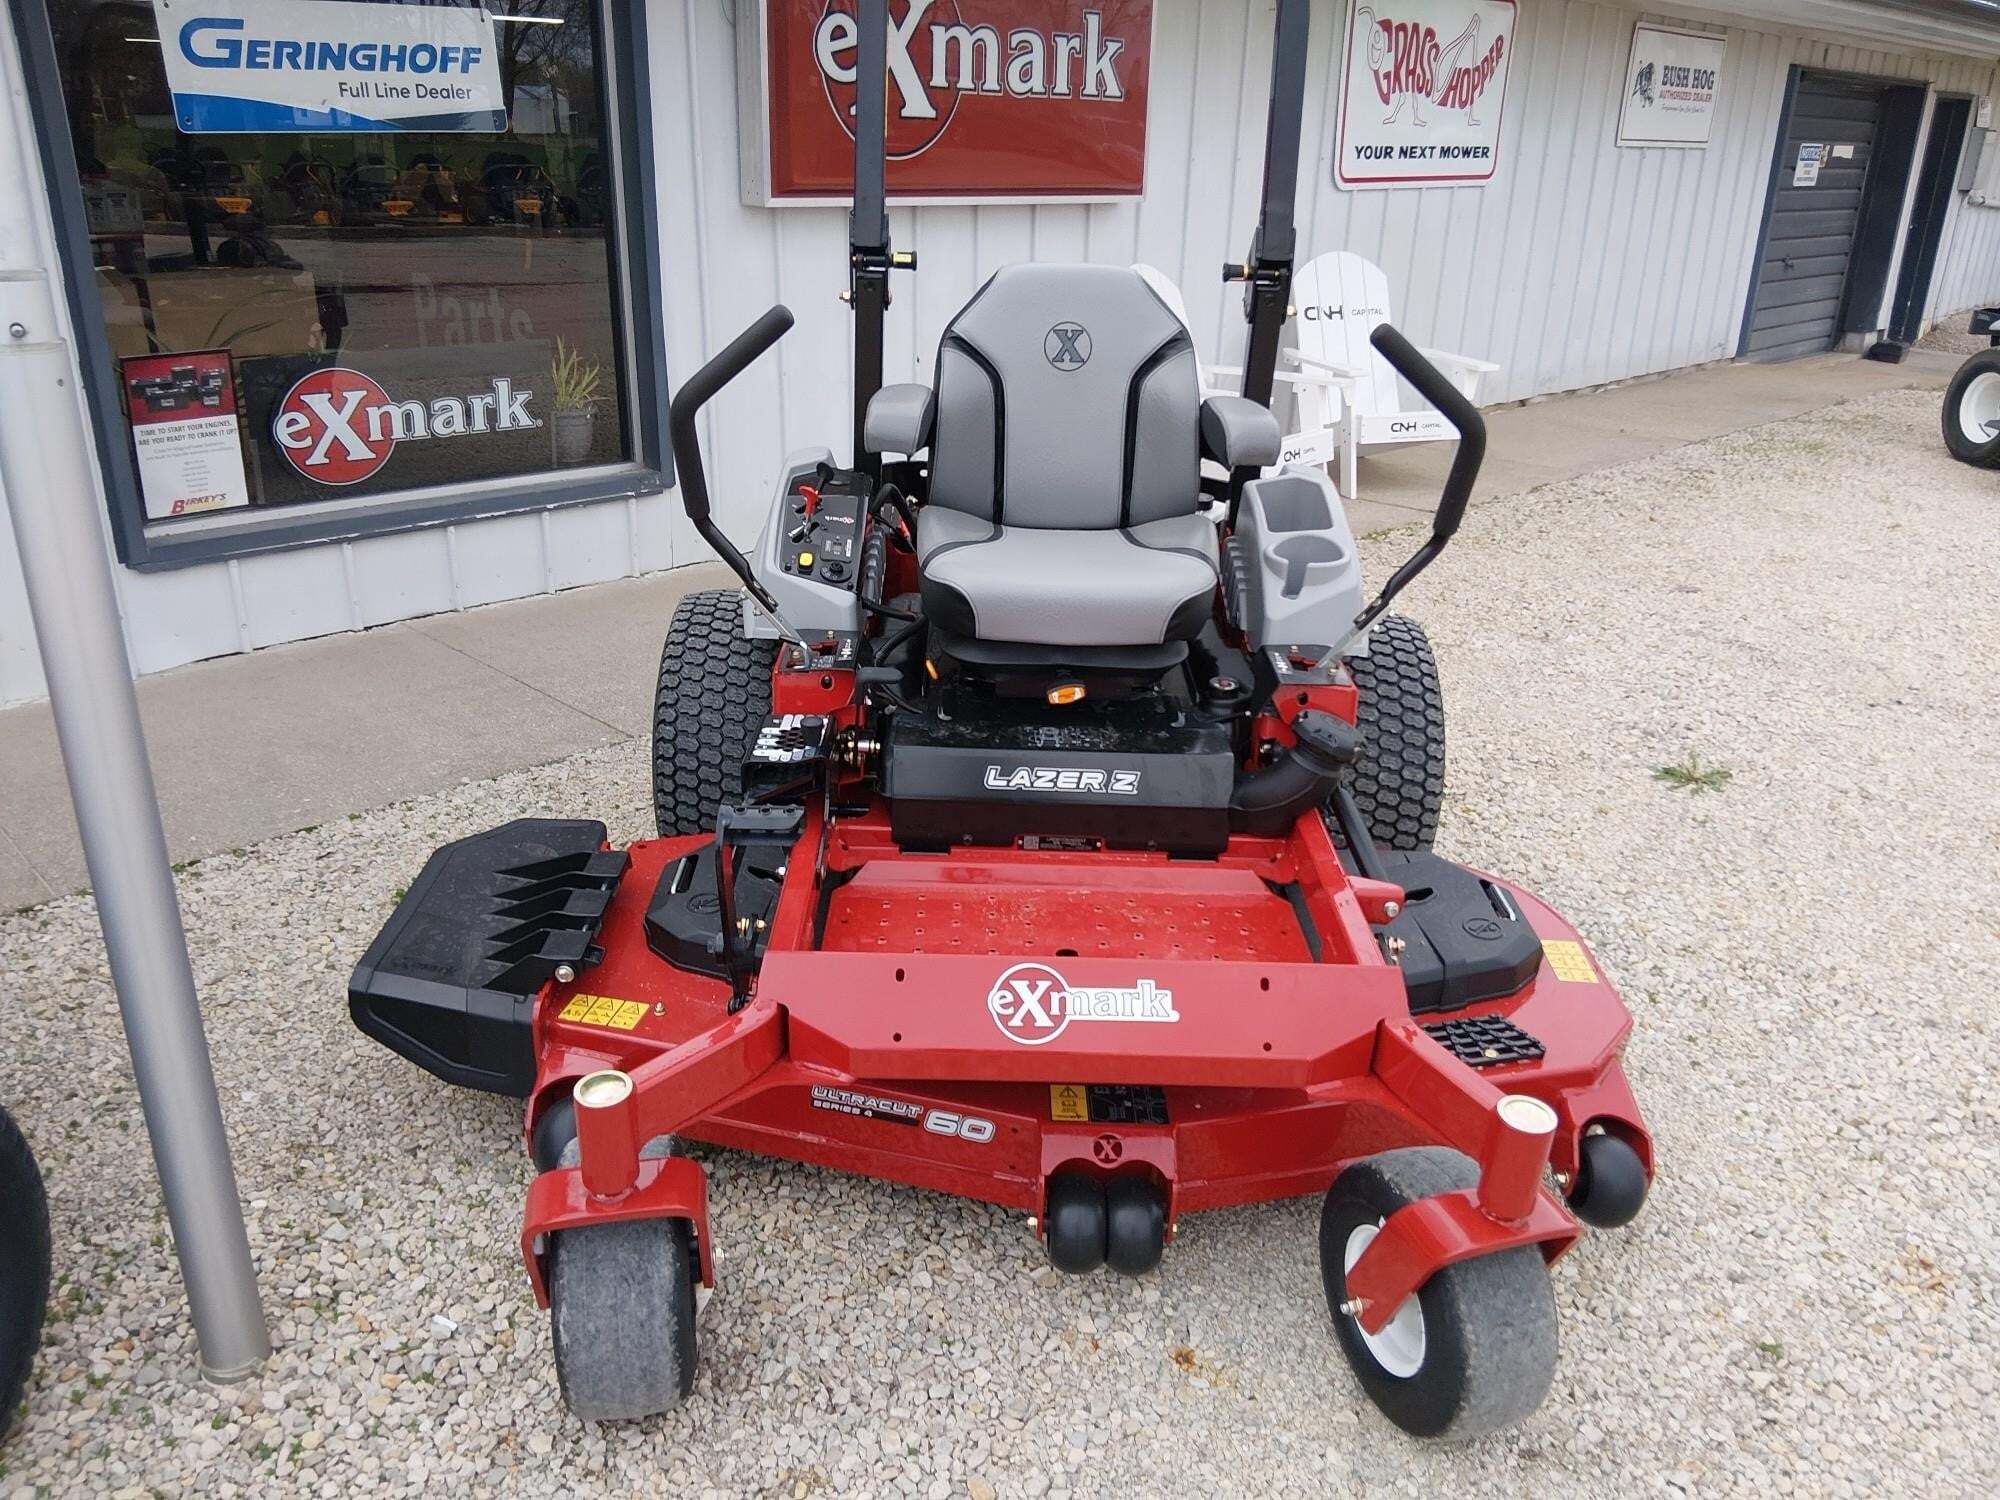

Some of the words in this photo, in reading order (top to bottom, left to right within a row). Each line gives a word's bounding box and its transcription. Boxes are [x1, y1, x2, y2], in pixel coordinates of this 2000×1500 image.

[179, 17, 481, 74] GERINGHOFF
[1661, 65, 1690, 88] BUSH
[1692, 68, 1715, 90] HOG
[338, 81, 370, 98] Full
[374, 82, 410, 99] Line
[415, 83, 472, 100] Dealer
[1354, 145, 1394, 160] YOUR
[1398, 145, 1436, 159] NEXT
[1439, 145, 1490, 159] MOWER
[1304, 305, 1344, 321] CNH
[140, 429, 156, 437] TIME
[168, 425, 186, 434] START
[187, 423, 203, 431] YOUR
[1390, 421, 1417, 433] CNH
[167, 435, 186, 444] READY
[197, 430, 217, 439] CRANK
[984, 765, 1106, 793] LAZER
[1108, 769, 1141, 795] Z
[812, 1085, 923, 1119] ULTRACUT
[924, 1110, 995, 1144] 60
[813, 1099, 861, 1117] SERIES
[863, 1109, 873, 1117] 4
